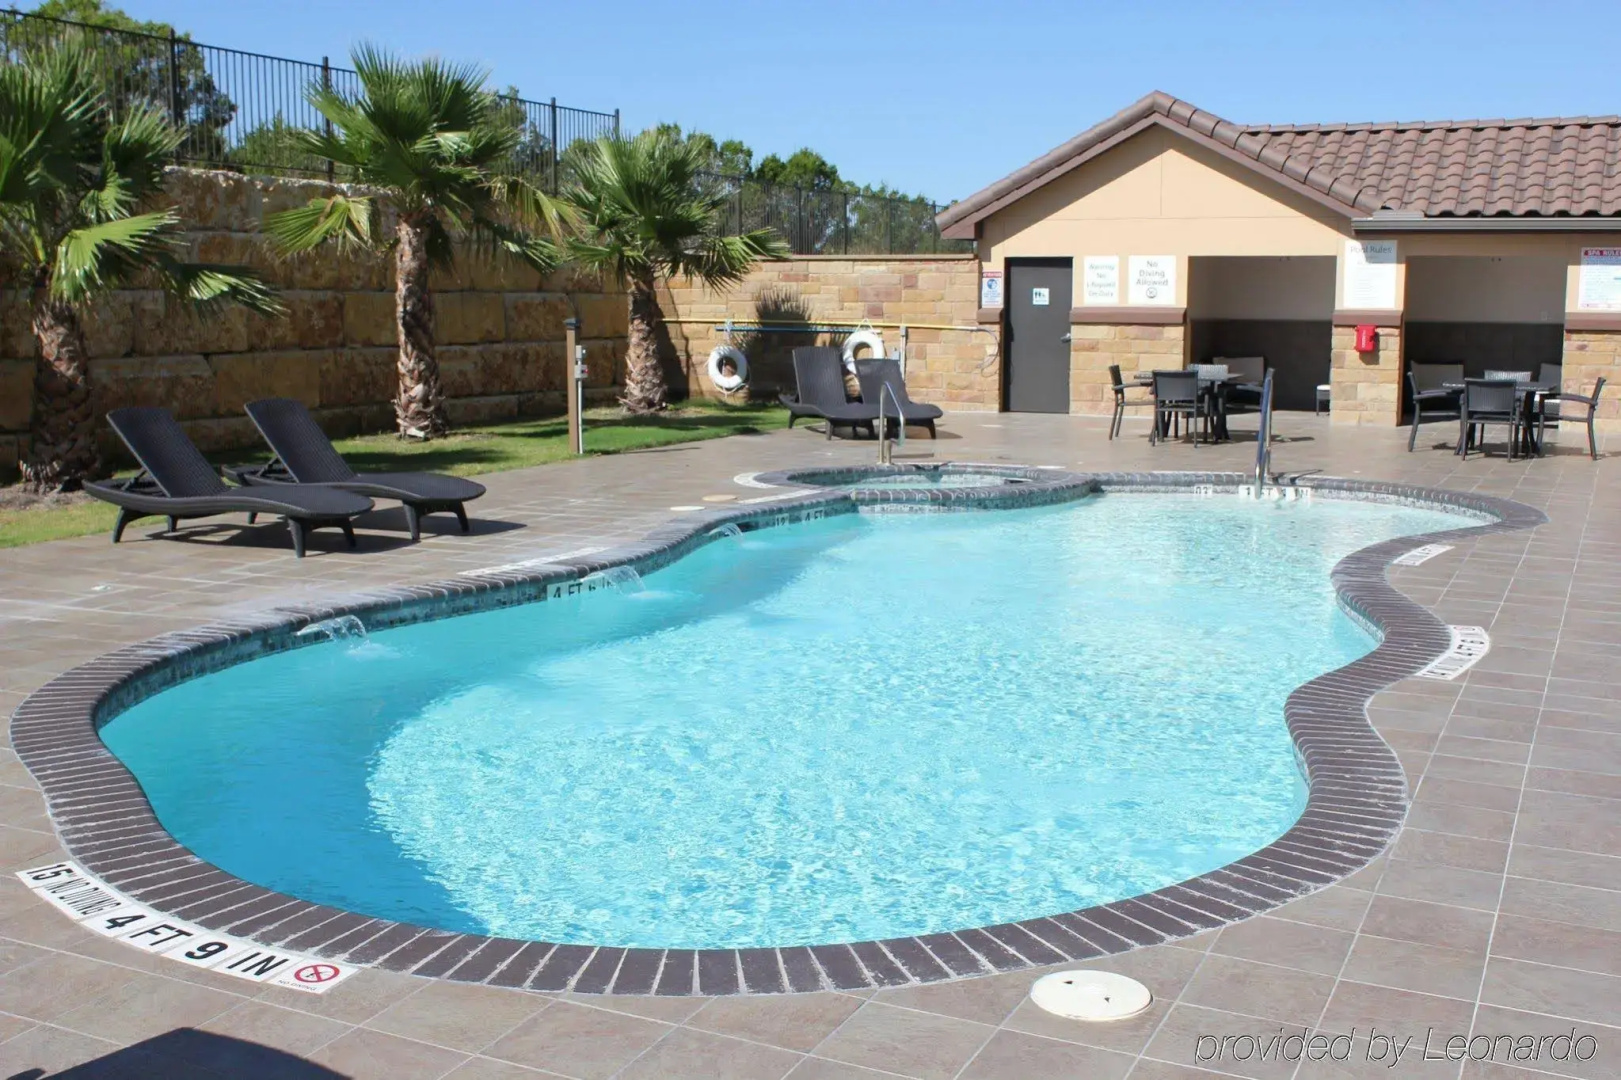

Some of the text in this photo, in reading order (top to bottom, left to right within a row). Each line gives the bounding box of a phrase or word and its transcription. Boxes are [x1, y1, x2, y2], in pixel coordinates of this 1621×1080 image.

[1350, 245, 1393, 254] Pool Rules
[1146, 260, 1158, 268] No
[1139, 269, 1165, 278] Diving
[1136, 278, 1169, 286] Allowed
[553, 586, 562, 599] 4
[568, 582, 583, 596] FT
[105, 913, 290, 978] 4 FT 9 IN
